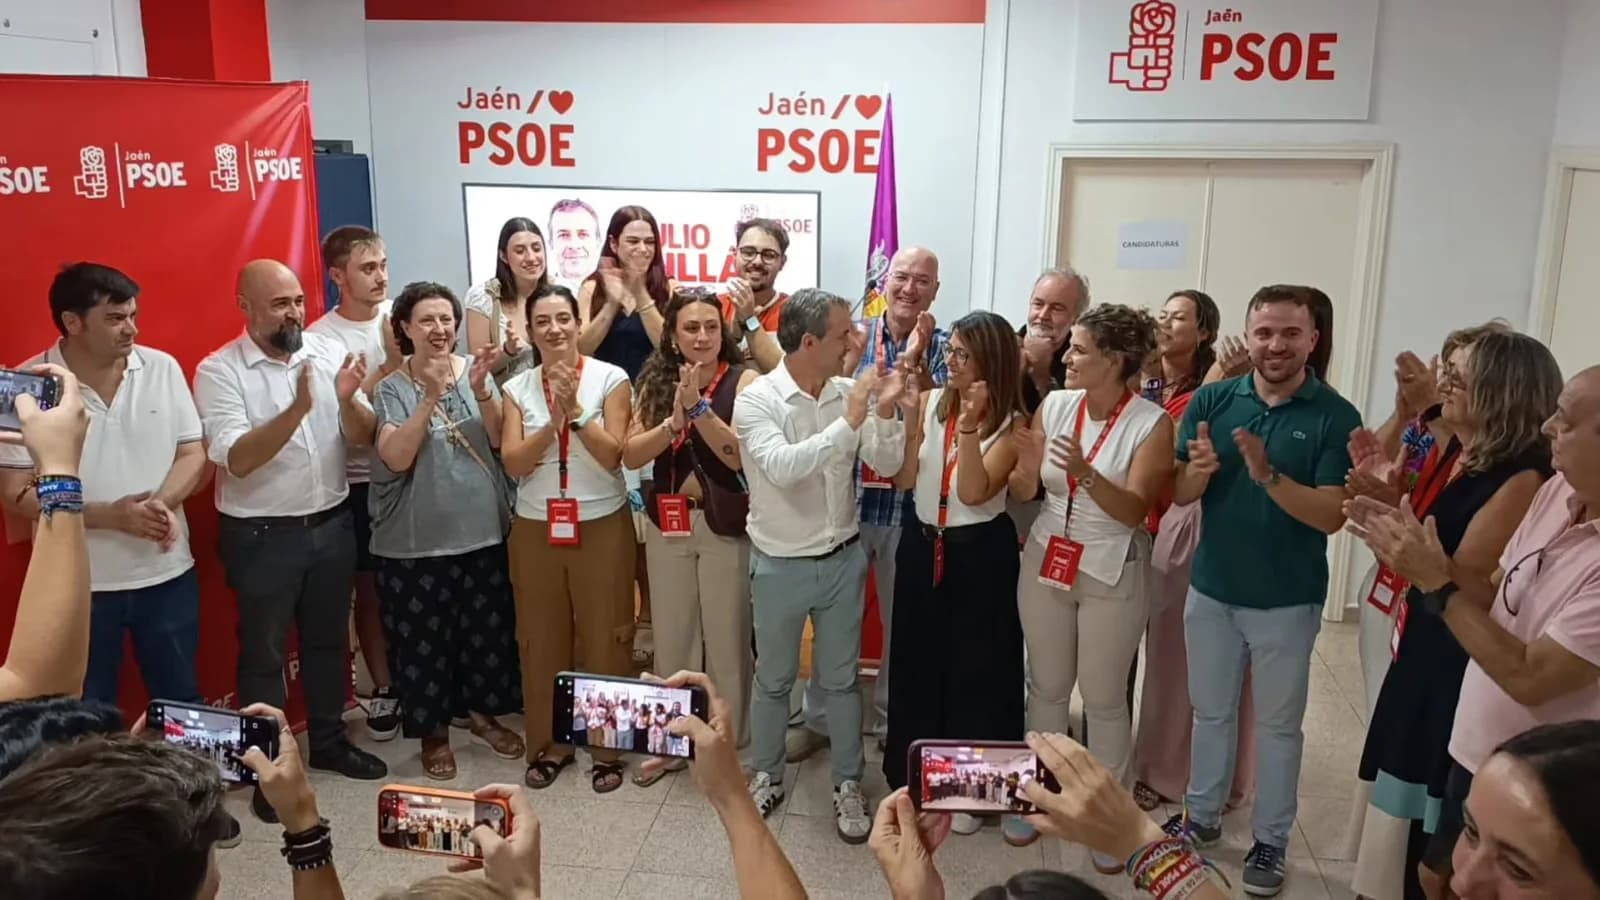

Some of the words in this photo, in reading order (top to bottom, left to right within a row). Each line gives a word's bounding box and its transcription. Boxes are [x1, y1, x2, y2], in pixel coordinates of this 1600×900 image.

[1205, 9, 1243, 26] Jaén
[1200, 32, 1338, 81] PSOE
[457, 87, 521, 111] Jaén
[757, 92, 825, 116] Jaén
[125, 151, 151, 162] Jaén
[254, 148, 277, 158] Jaén
[458, 121, 576, 168] PSOE
[757, 128, 881, 174] PSOE
[0, 166, 51, 195] SOE
[126, 162, 187, 188] PSOE
[255, 157, 302, 182] PSOE
[1122, 240, 1180, 248] CANDIDATURAS
